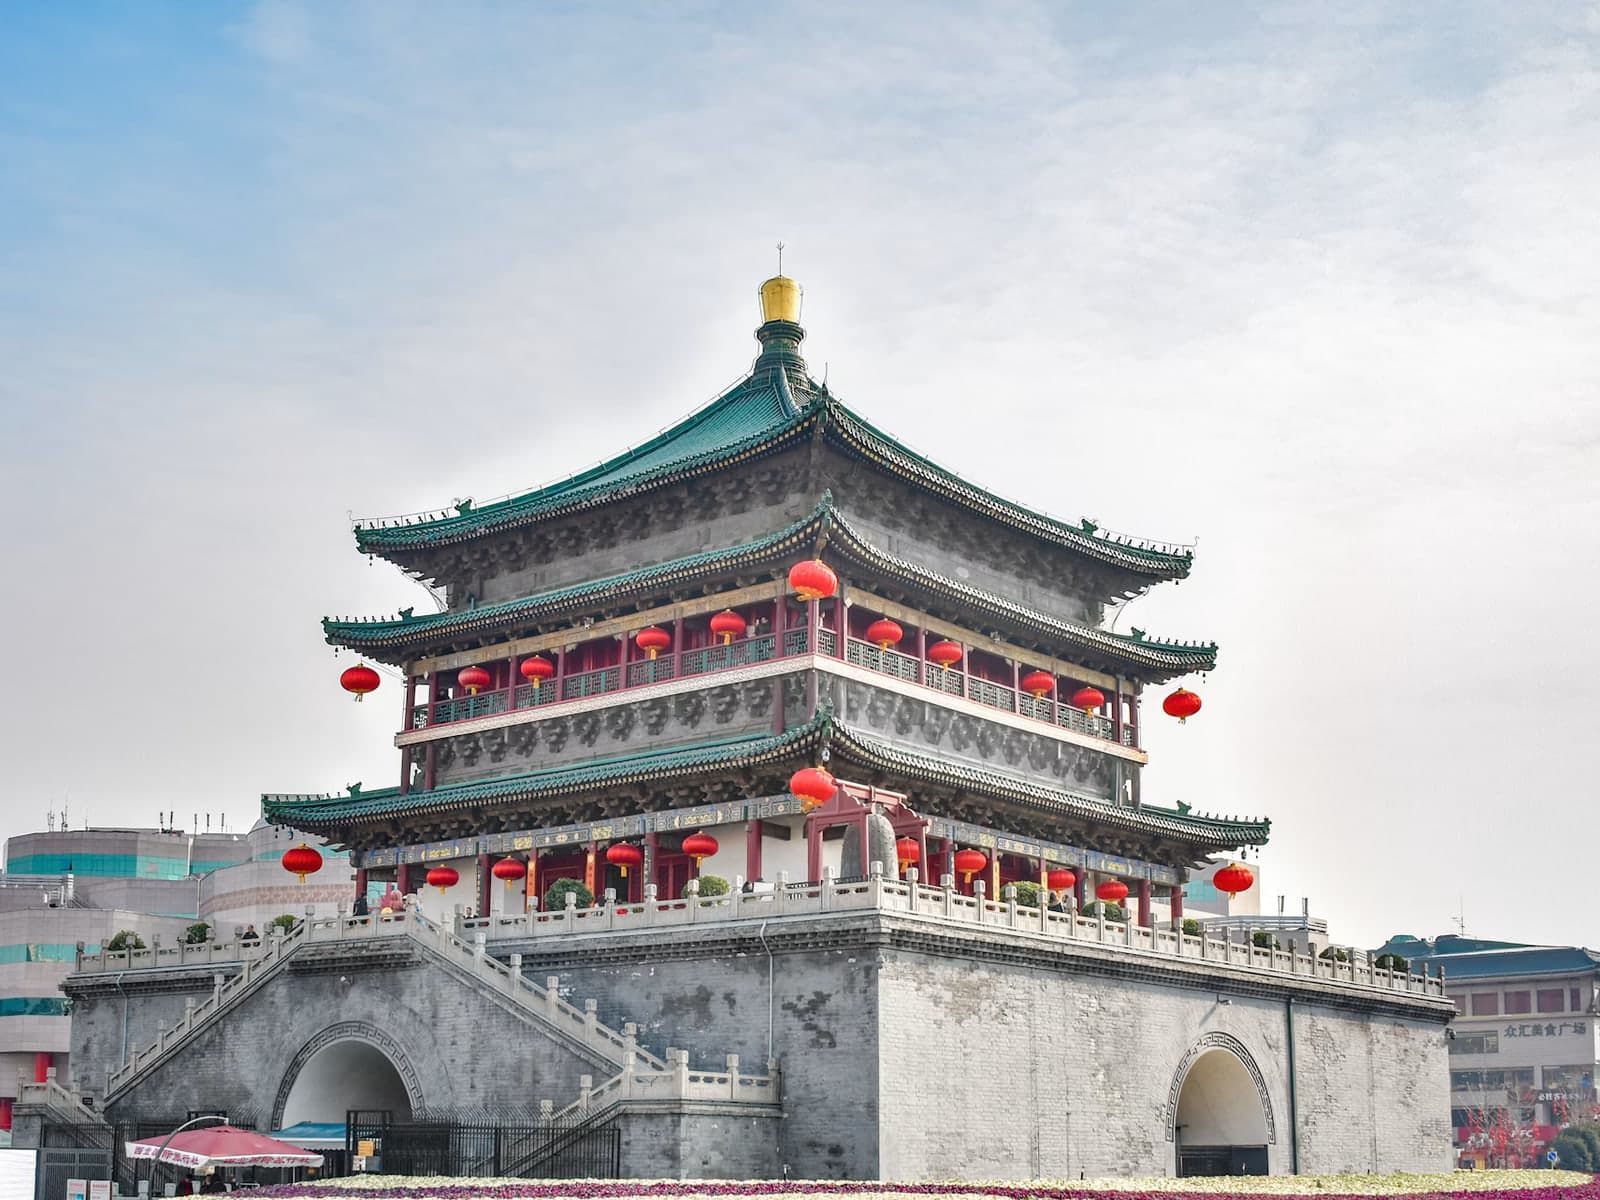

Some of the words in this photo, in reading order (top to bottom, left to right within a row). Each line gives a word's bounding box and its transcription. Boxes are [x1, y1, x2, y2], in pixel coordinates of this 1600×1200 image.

[1504, 1022, 1587, 1038] 众汇美食广场
